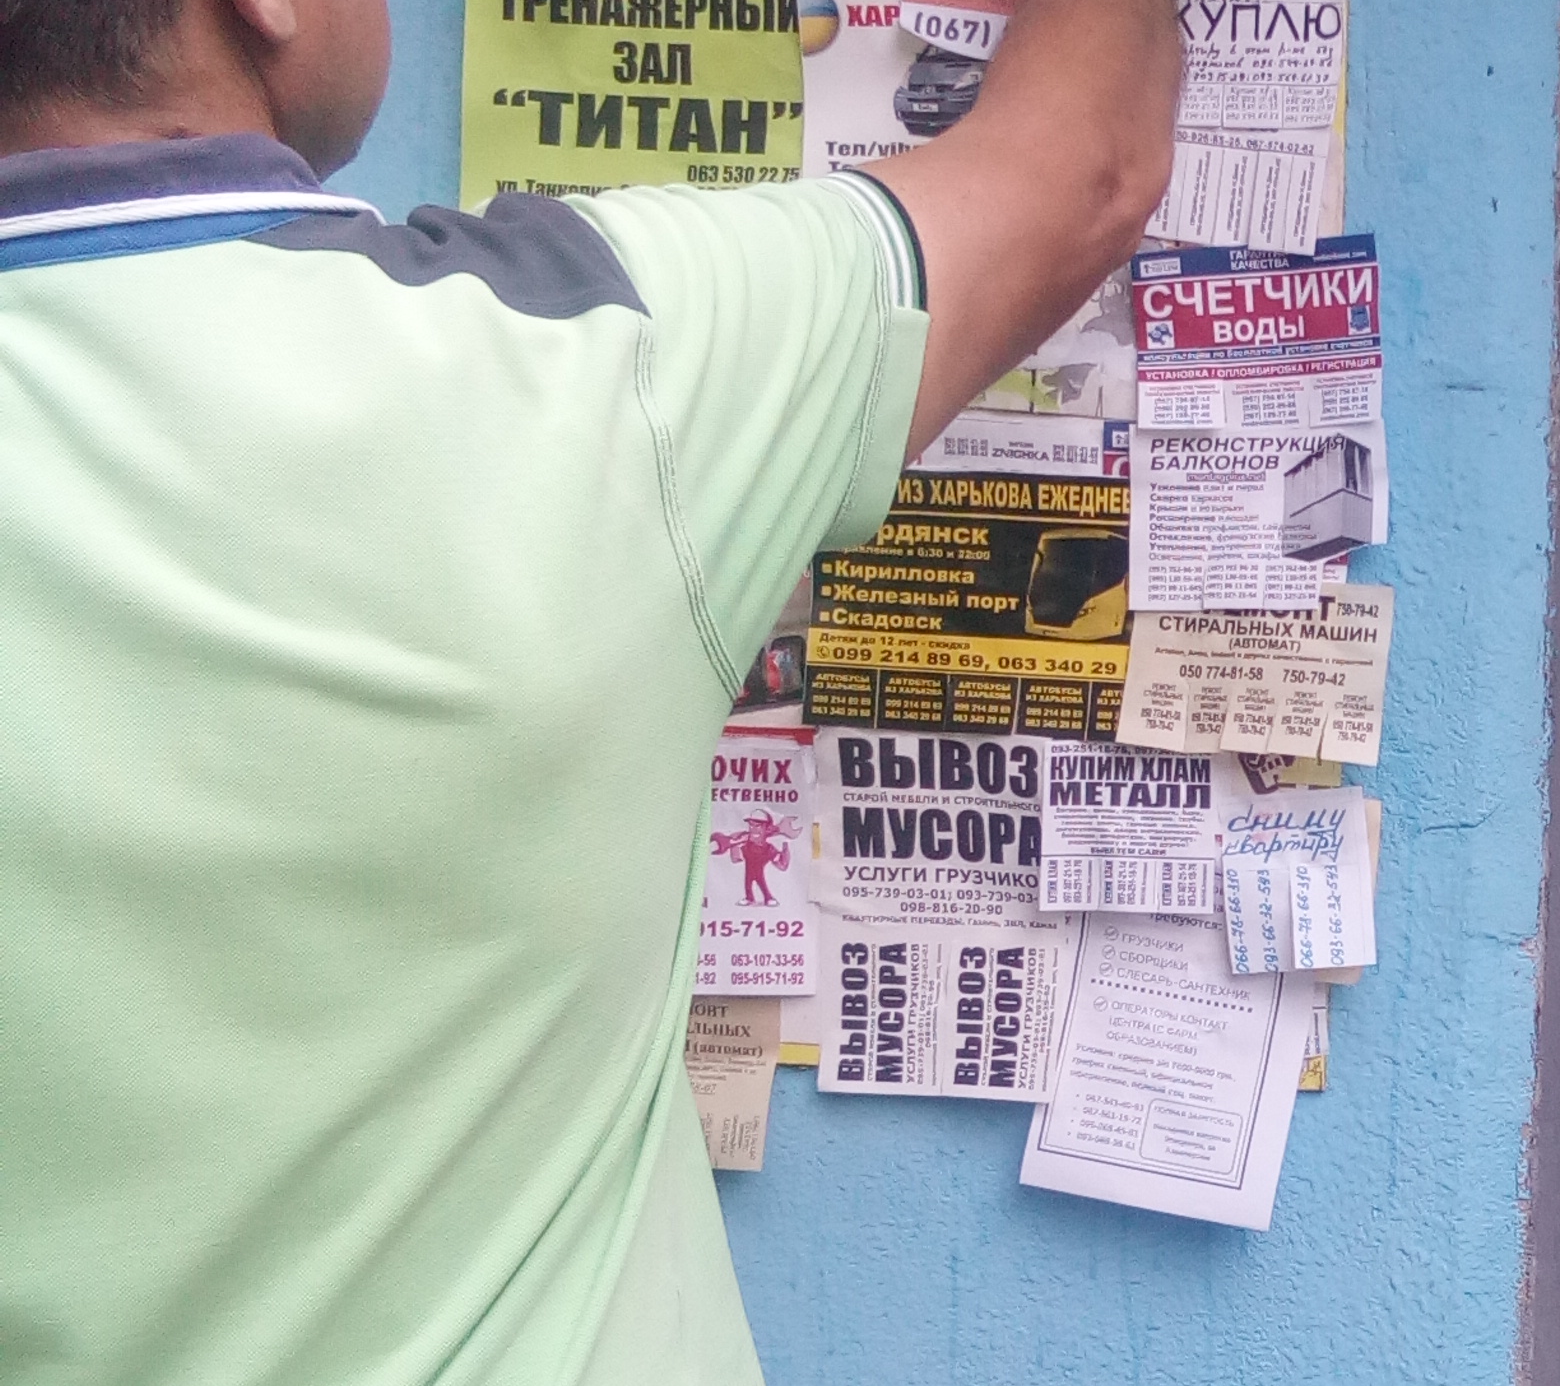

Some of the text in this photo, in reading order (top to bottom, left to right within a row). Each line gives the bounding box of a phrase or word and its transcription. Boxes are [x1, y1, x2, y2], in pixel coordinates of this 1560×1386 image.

[914, 11, 991, 49] (067)
[612, 40, 693, 85] ЗАЛ
[687, 165, 800, 184] 063 530 22 75
[1230, 258, 1290, 271] КАЧЕСТВА
[1142, 268, 1373, 319] СЧЕТЧИКИ
[1212, 315, 1305, 346] ВОДЫ
[1145, 369, 1209, 380] УСТАНОВКА
[1150, 434, 1347, 454] РЕКОНСТРУКЦИЯ
[1150, 455, 1280, 471] БАЛКОНОВ
[899, 478, 1032, 510] ИЗ ХАРЬКОВА
[876, 523, 990, 546] рдянск
[834, 559, 976, 584] Кирилловка
[832, 583, 1020, 614] Железный порт
[832, 608, 943, 631] Скадовск
[1159, 615, 1378, 644] СТИРАЛЬНЫХ МАШИН
[819, 632, 858, 644] Детям
[860, 636, 876, 645] до
[880, 636, 894, 646] 12
[1228, 637, 1302, 653] (АВТОМАТ)
[832, 646, 1117, 676] 099 214 89 69, 063 340 29
[1179, 664, 1346, 687] 050 774-81-58 750-79-42
[710, 755, 793, 785] ОЧИХ
[837, 736, 1039, 799] ВЫВОЗ
[1050, 755, 1211, 784] КУПИМ ХЛАМ
[710, 787, 799, 804] ЕСТВЕННО
[843, 791, 1042, 813] СТАРОЙ МЕБЕЛИ И СТРОИТЕЛЬНОГО
[1049, 782, 1212, 810] МЕТАЛЛ
[841, 805, 1043, 868] МУСОРА
[843, 866, 1040, 889] УСЛУГИ ГРУЗЧИКО
[842, 886, 953, 902] 095-739-03-01;
[899, 901, 1004, 916] 098-816-20-90
[1121, 932, 1184, 953] ГРУЗЧИКИ
[731, 953, 805, 967] 063-107-33-56
[1118, 950, 1189, 973] СБОРЩИКИ
[731, 971, 805, 986] 095-915-71-92
[1116, 966, 1251, 1002] СЛЕСАРЬ-САНТЕХНИК
[837, 942, 869, 1081] ВЫВОЗ
[875, 942, 908, 1083] МУСОРА
[906, 943, 920, 1084] УСЛУГИ ГРУЗЧИКОВ
[952, 946, 987, 1086] ВЫВОЗ
[988, 946, 1026, 1089] МУСОРА
[1018, 947, 1037, 1089] УСЛУГИ ГРУЗЧИКОВ
